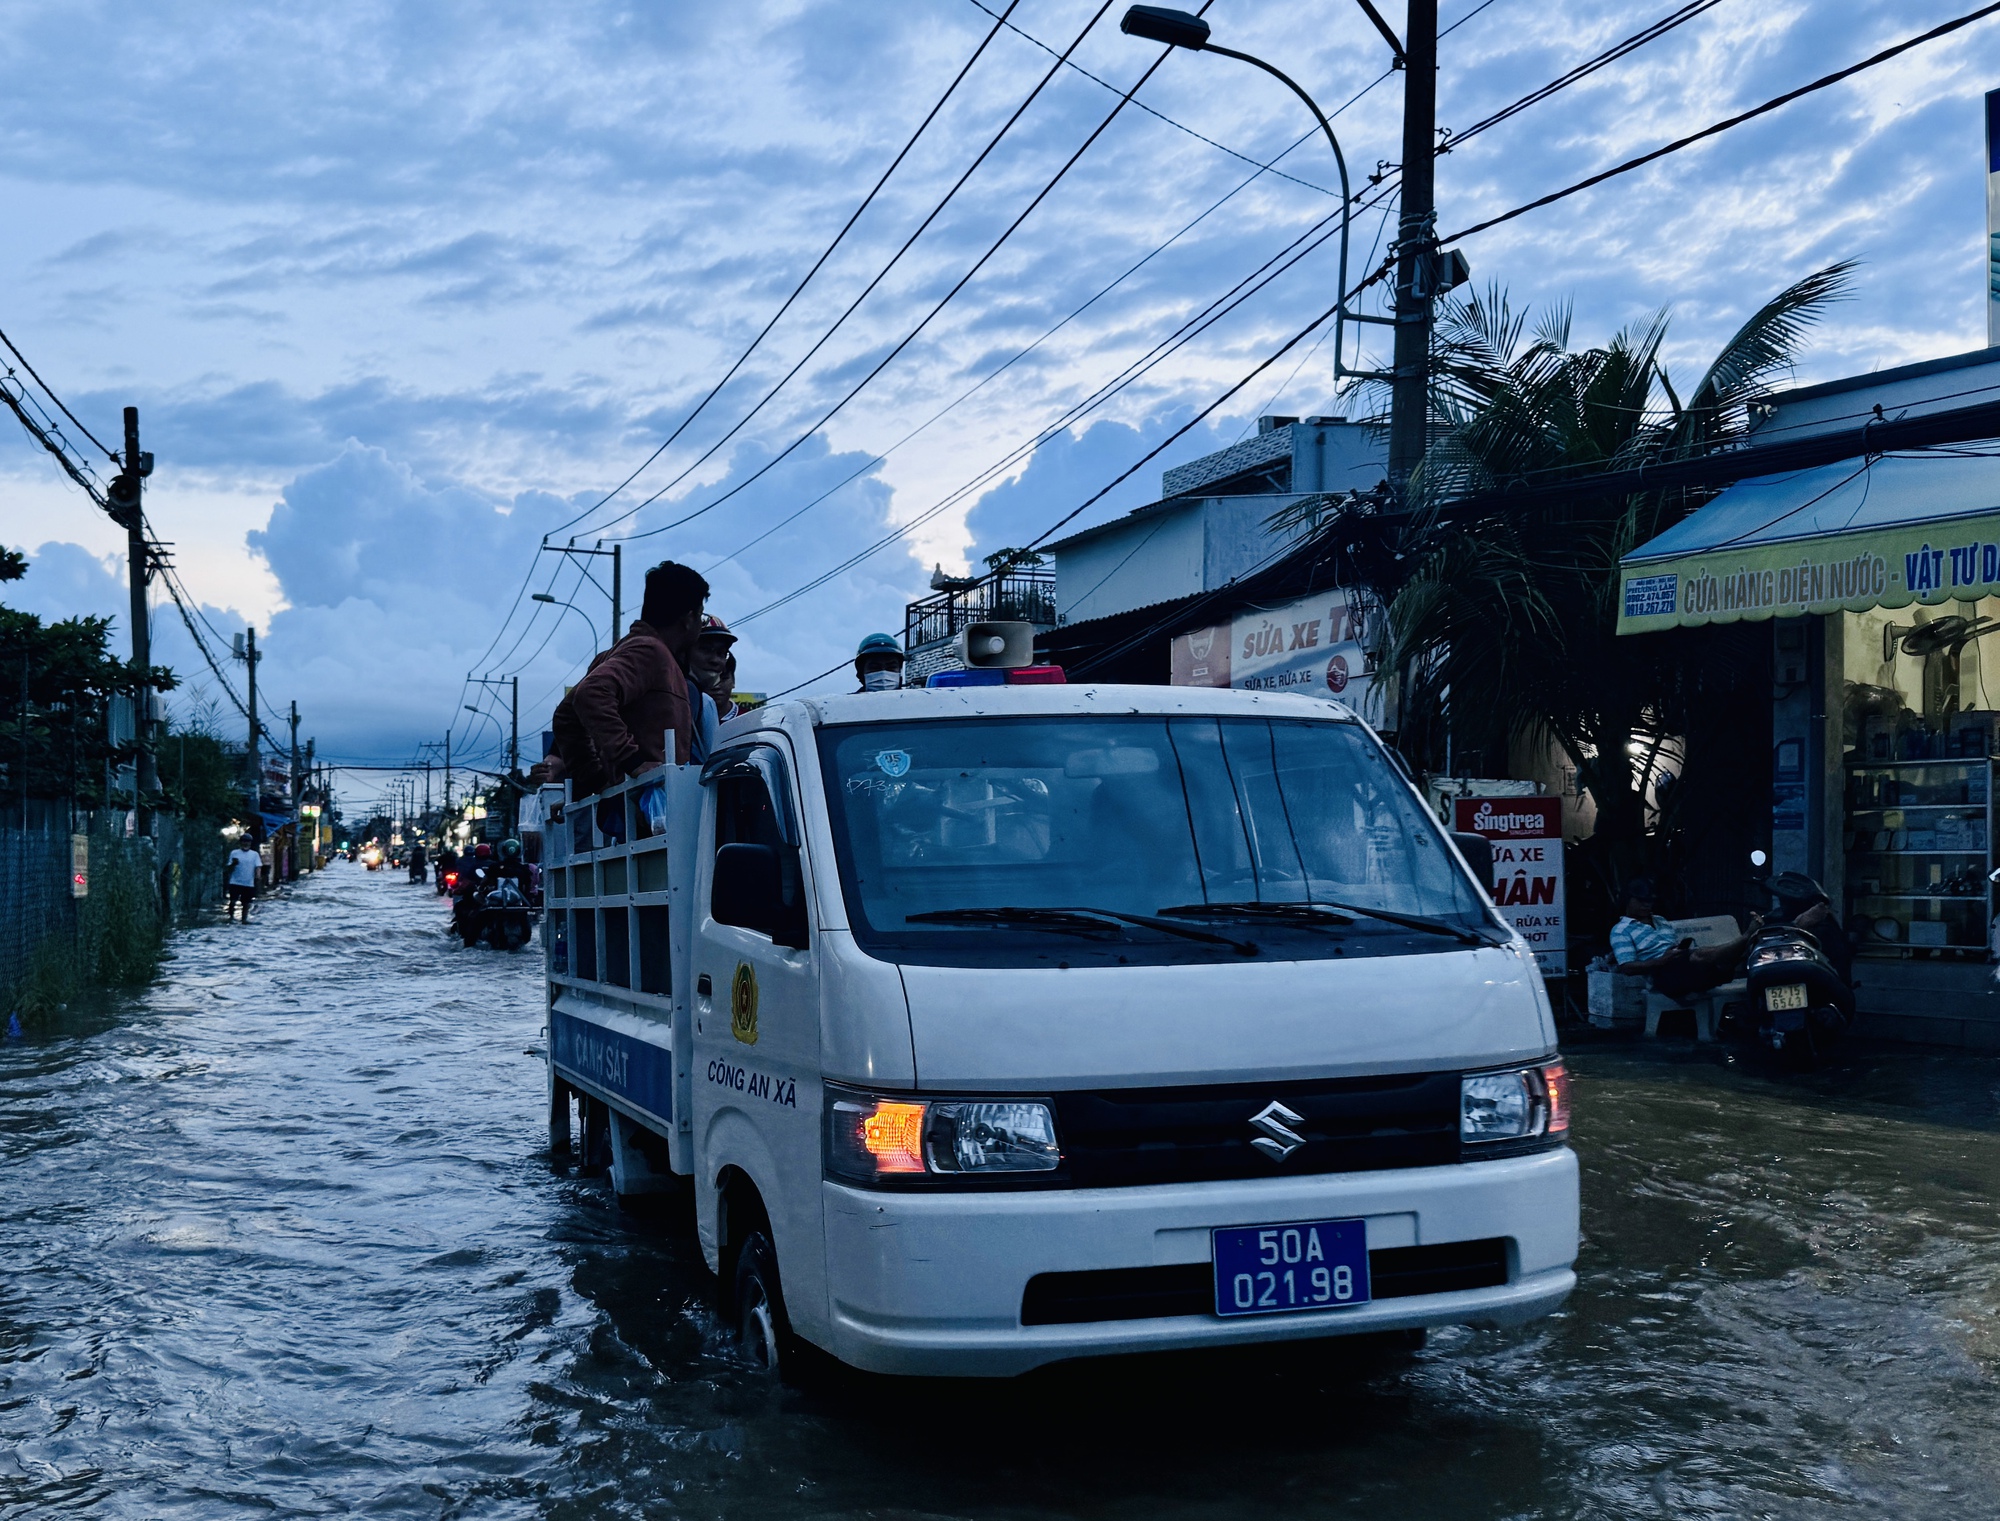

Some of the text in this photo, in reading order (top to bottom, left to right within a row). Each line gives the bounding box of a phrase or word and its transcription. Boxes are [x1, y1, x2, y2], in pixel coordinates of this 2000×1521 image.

[1683, 567, 1718, 614] CỬA
[1724, 566, 1775, 610] HÀNG
[1829, 551, 1885, 600] NƯỚC
[1905, 543, 1944, 598] VẬT
[1949, 541, 1979, 587] TƯ
[1242, 619, 1284, 660] SỬA
[1289, 619, 1322, 651] XE
[1244, 669, 1312, 691] SỬA XE, RỬA XE
[1473, 812, 1545, 832] Singtrea
[1520, 847, 1544, 862] XE
[1516, 914, 1542, 928] RỬA
[1545, 916, 1560, 926] XE
[605, 1039, 629, 1088] SÁT
[707, 1056, 798, 1109] CÔNG AN XÃ
[1258, 1227, 1325, 1266] 50A
[1233, 1264, 1354, 1309] 021.98
